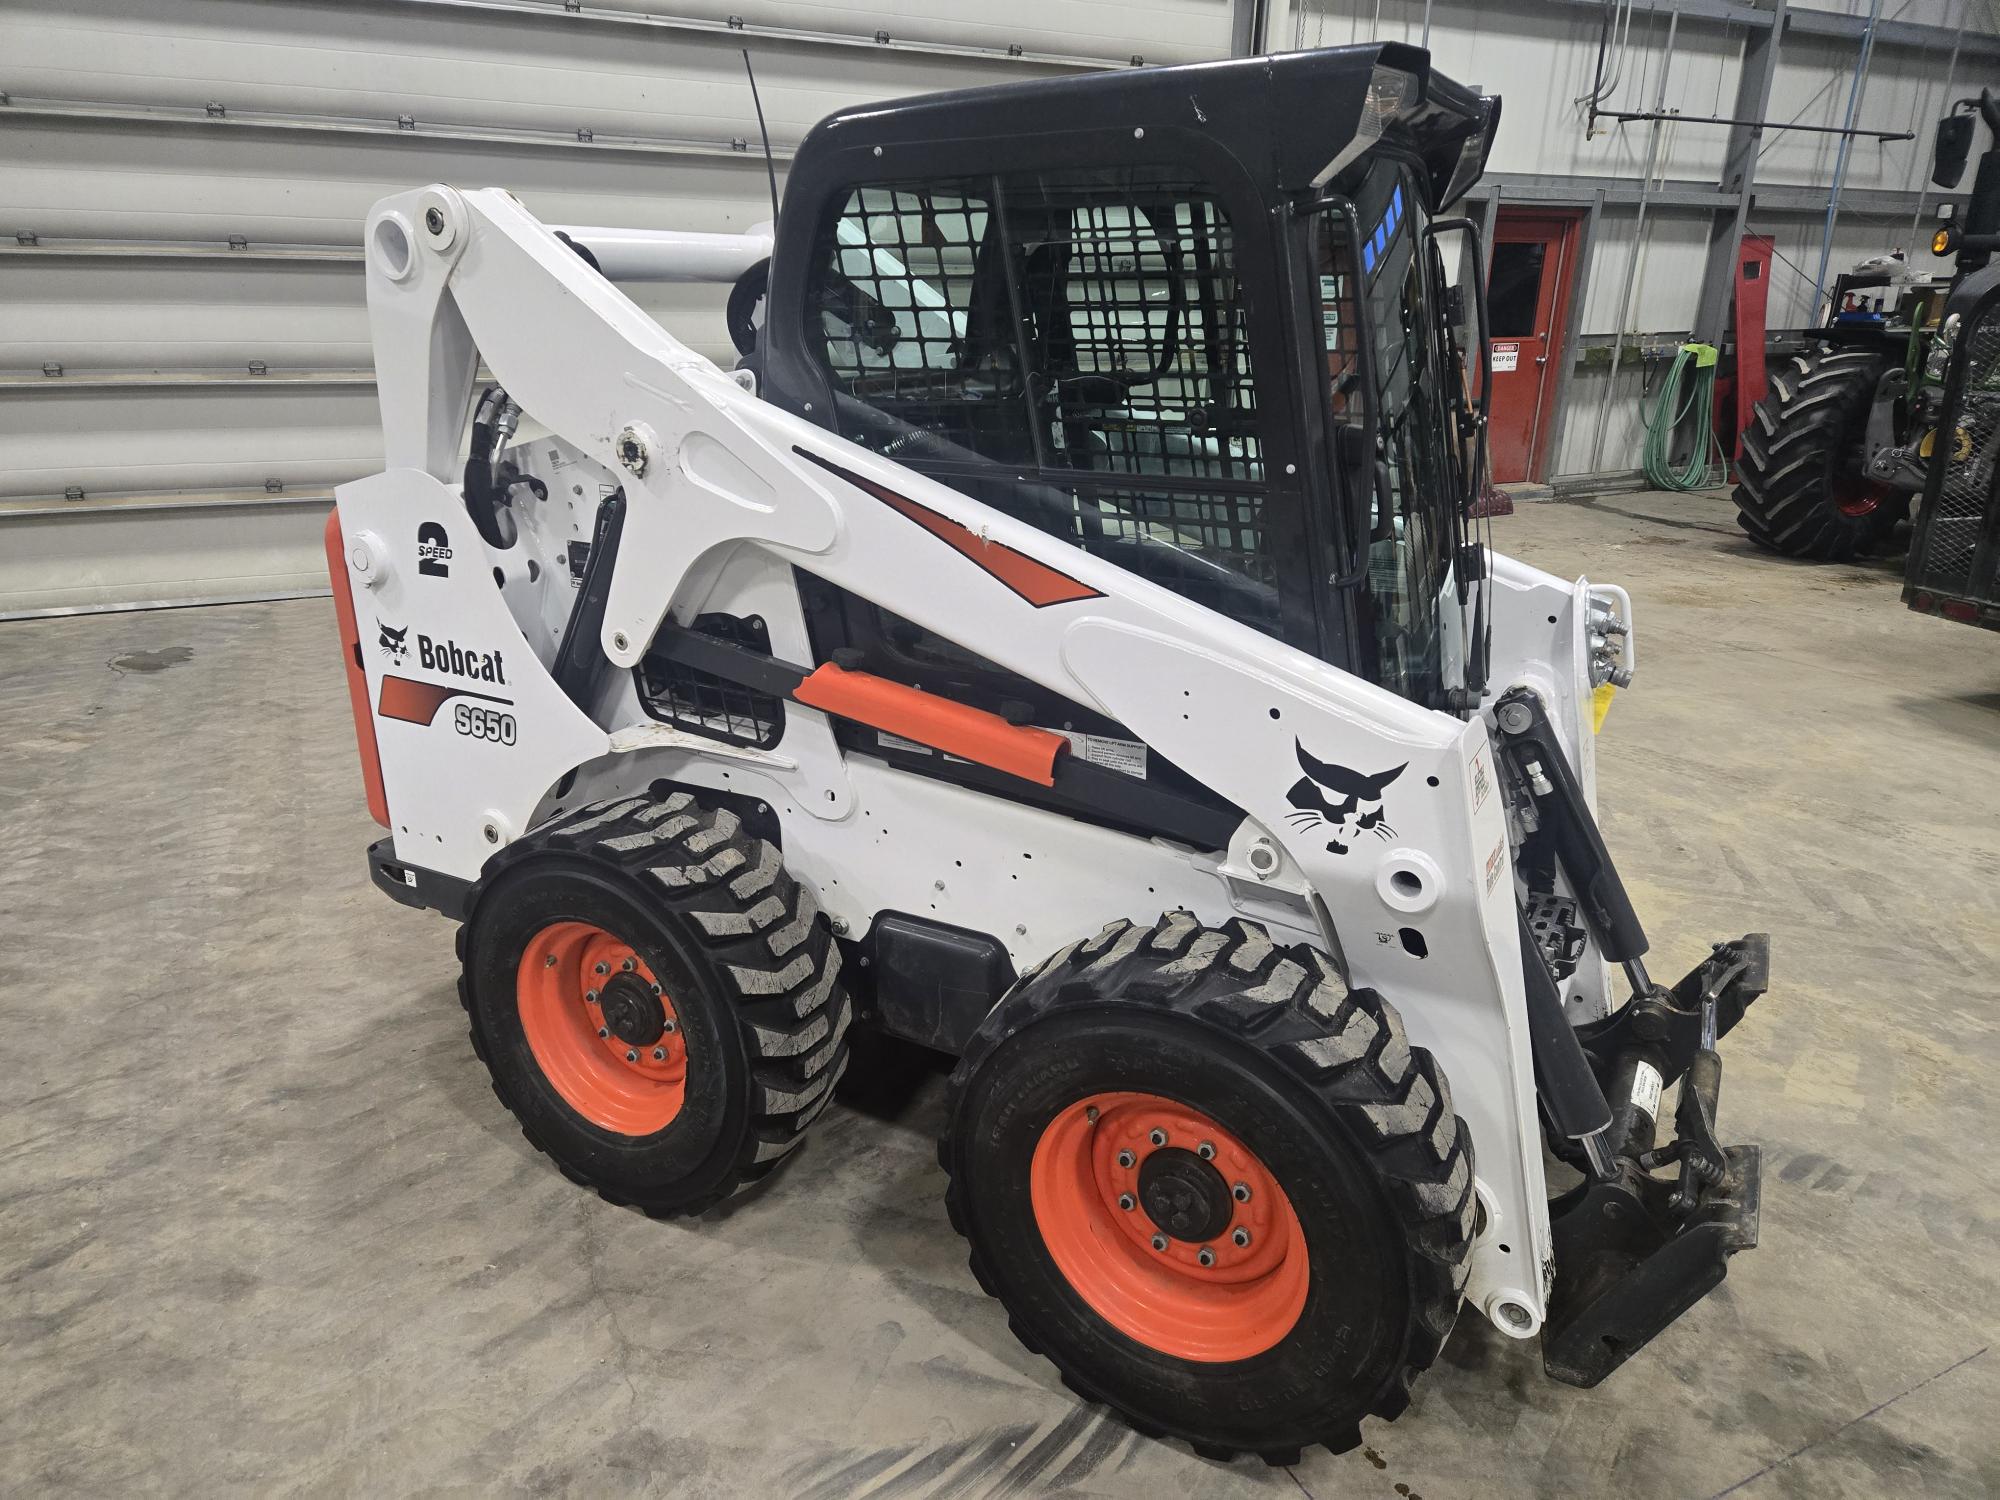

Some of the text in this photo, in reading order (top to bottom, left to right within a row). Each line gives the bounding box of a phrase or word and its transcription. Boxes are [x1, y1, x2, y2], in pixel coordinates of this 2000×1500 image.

[418, 521, 453, 578] 2 SPEED
[417, 634, 506, 685] Bobcat
[454, 704, 517, 747] S650
